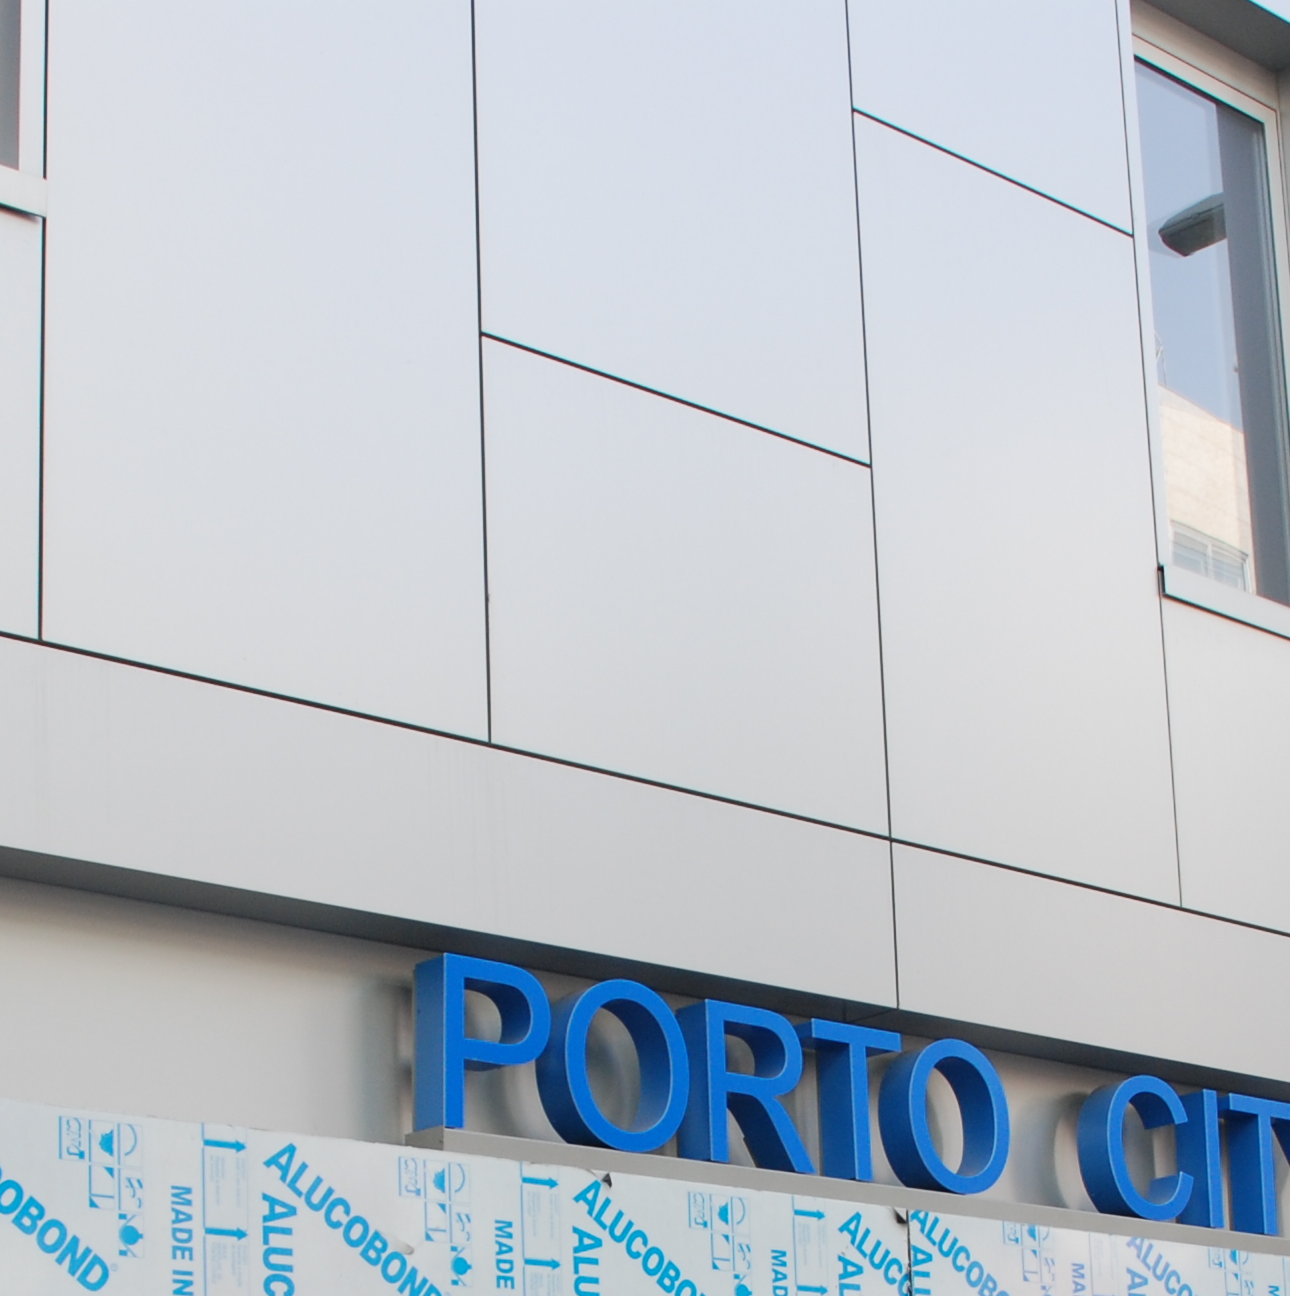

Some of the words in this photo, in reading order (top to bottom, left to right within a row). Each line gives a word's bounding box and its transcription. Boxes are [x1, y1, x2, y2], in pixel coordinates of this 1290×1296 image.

[414, 952, 1010, 1195] PORTO
[170, 1185, 194, 1261] MADE
[494, 1219, 516, 1290] MADE
